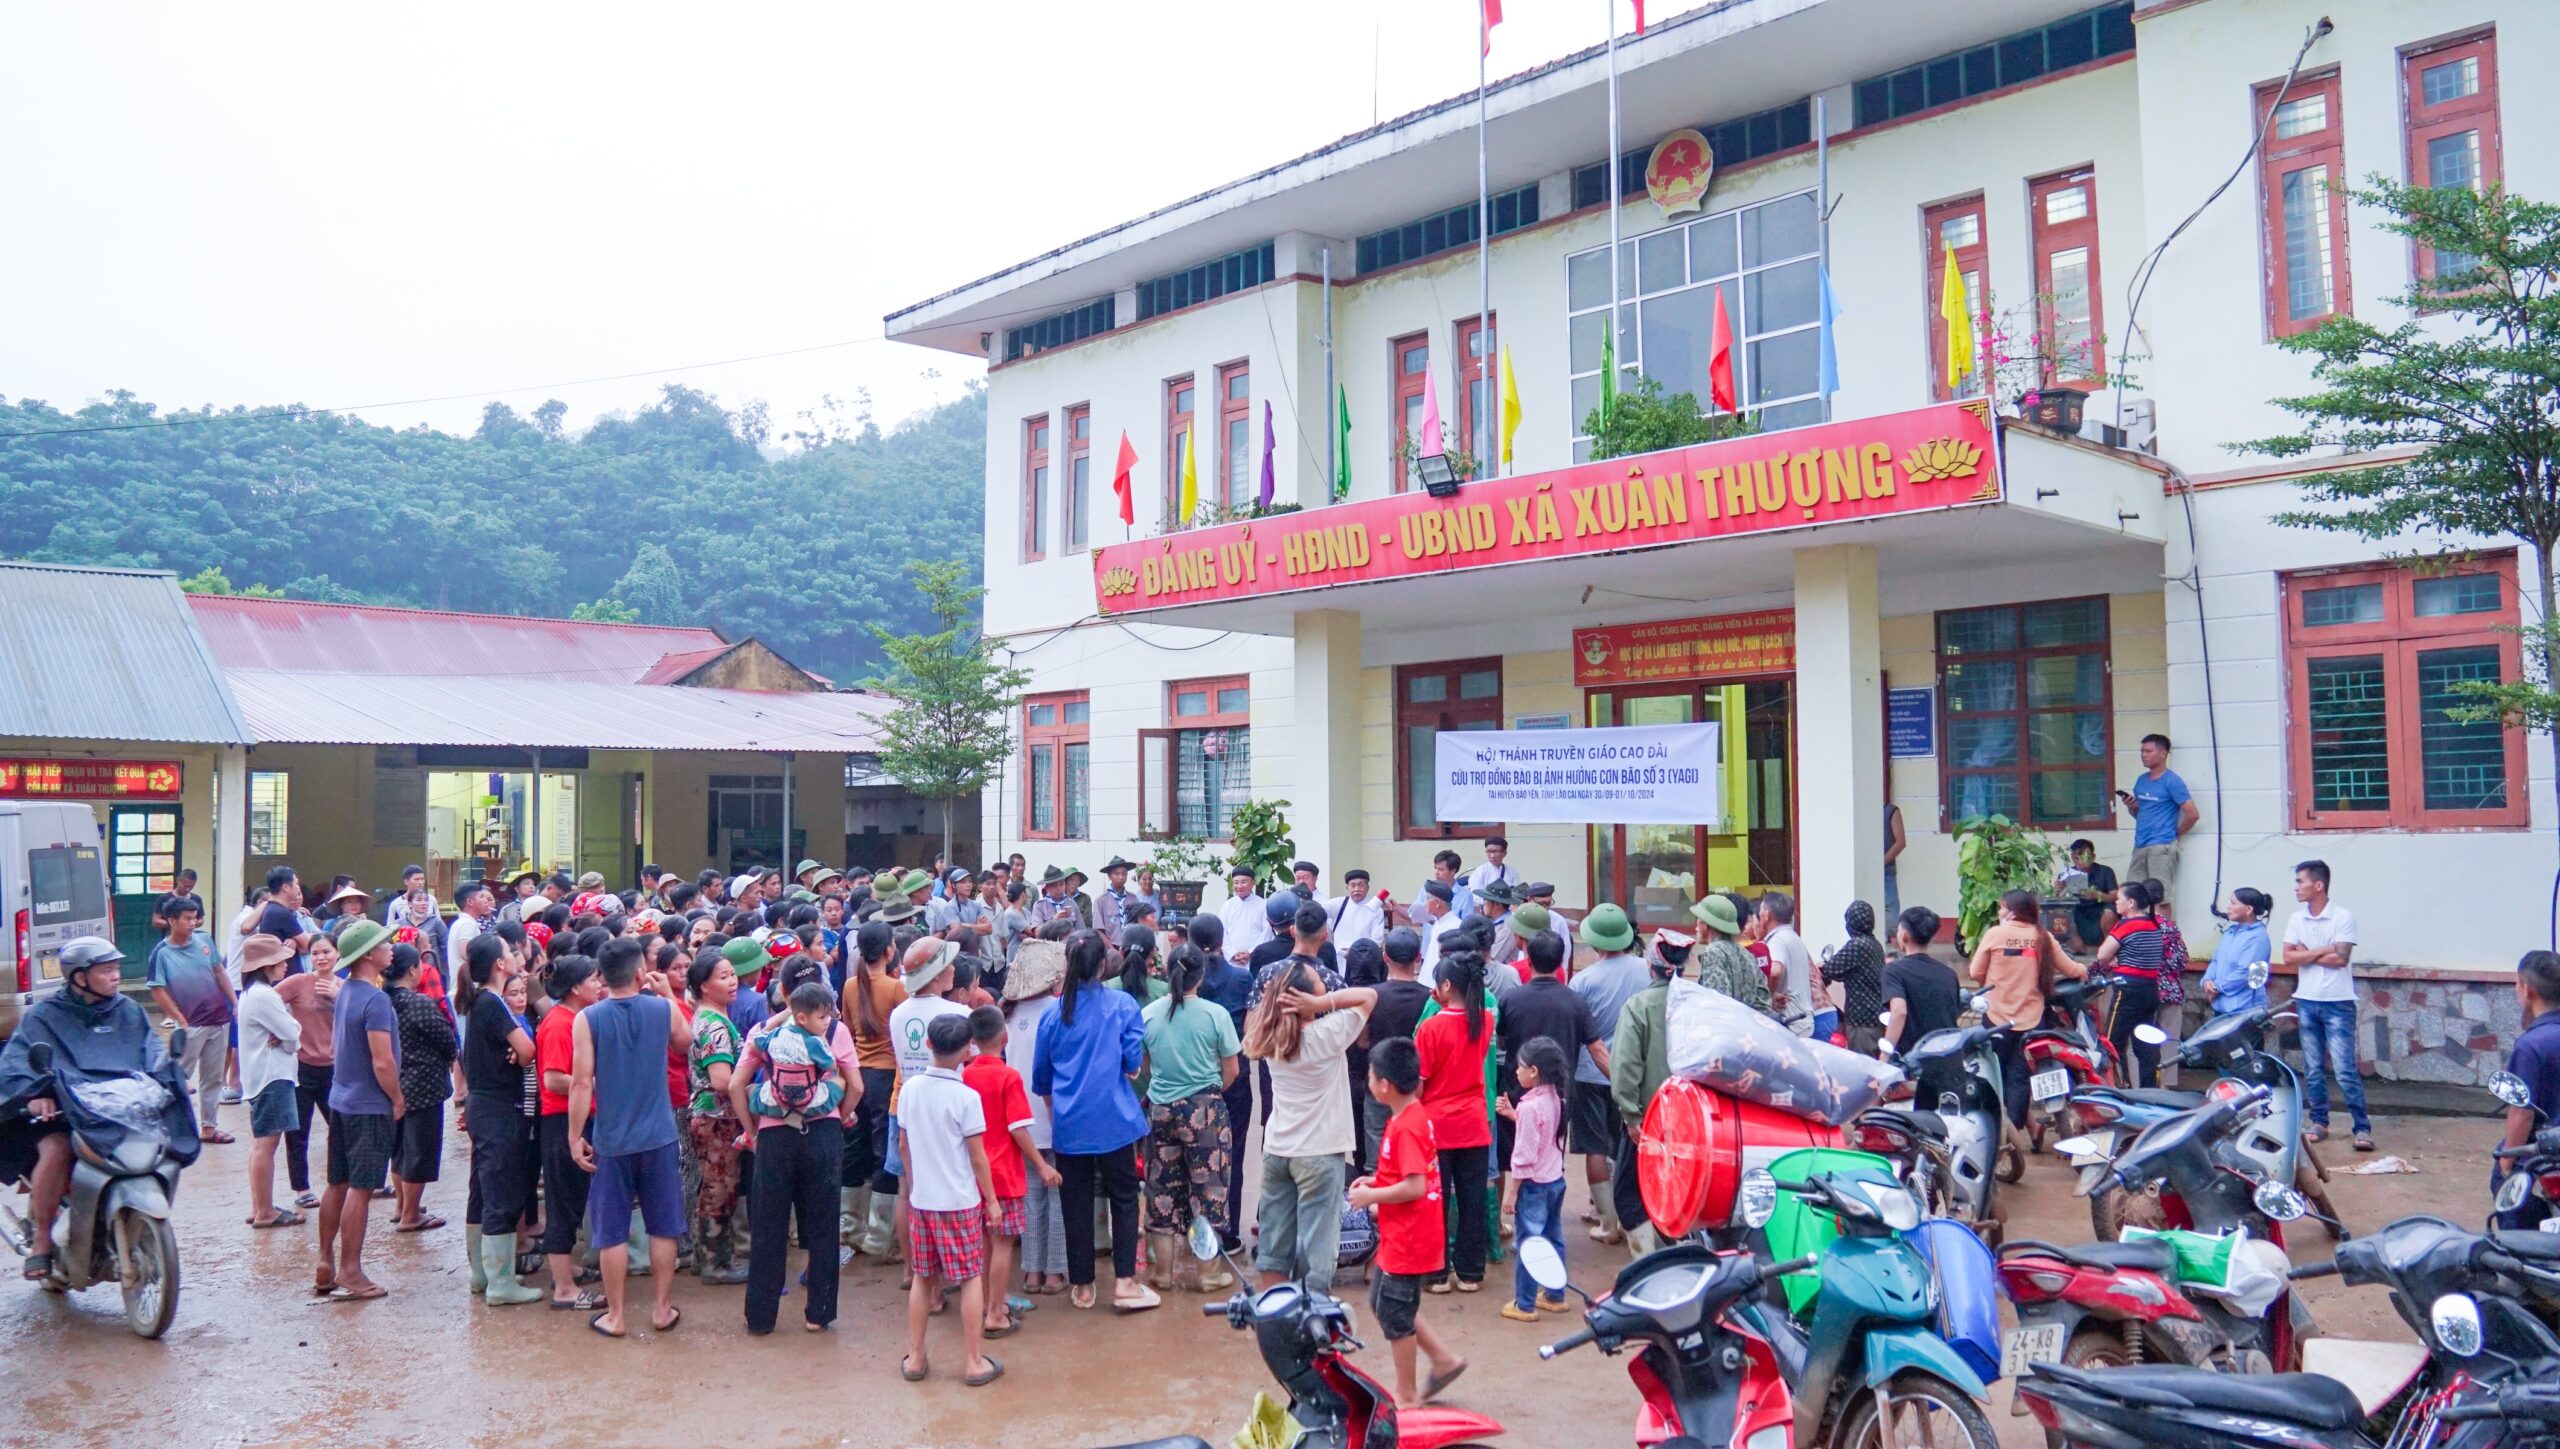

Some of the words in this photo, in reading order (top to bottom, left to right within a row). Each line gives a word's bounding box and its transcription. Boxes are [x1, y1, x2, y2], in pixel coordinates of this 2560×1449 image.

[1143, 539, 1216, 596] ĐẢNG
[1221, 525, 1256, 585] UỶ
[1266, 554, 1277, 564] -
[1282, 523, 1370, 576] HĐND
[1380, 534, 1392, 544] -
[1399, 504, 1497, 559] UBND
[1505, 482, 1563, 546] XÃ
[1570, 466, 1688, 538] XUÂN
[1697, 442, 1896, 520] THƯỢNG
[1499, 746, 1537, 761] THÁNH
[1540, 744, 1585, 760] TRUYỀN
[1588, 744, 1617, 760] GIÁO
[1620, 746, 1644, 759] CAO
[1648, 742, 1668, 759] ĐÀI
[1470, 770, 1486, 788] TRỢ
[1534, 770, 1542, 788] BỊ
[1565, 765, 1597, 785] HƯỞNG
[1599, 769, 1619, 785] CƠN
[1621, 766, 1640, 784] BÃO
[1643, 764, 1657, 784] SỐ
[1658, 769, 1665, 784] 3
[1594, 789, 1654, 799] 30/09-01/10/2024
[2011, 1328, 2054, 1351] 24-K8
